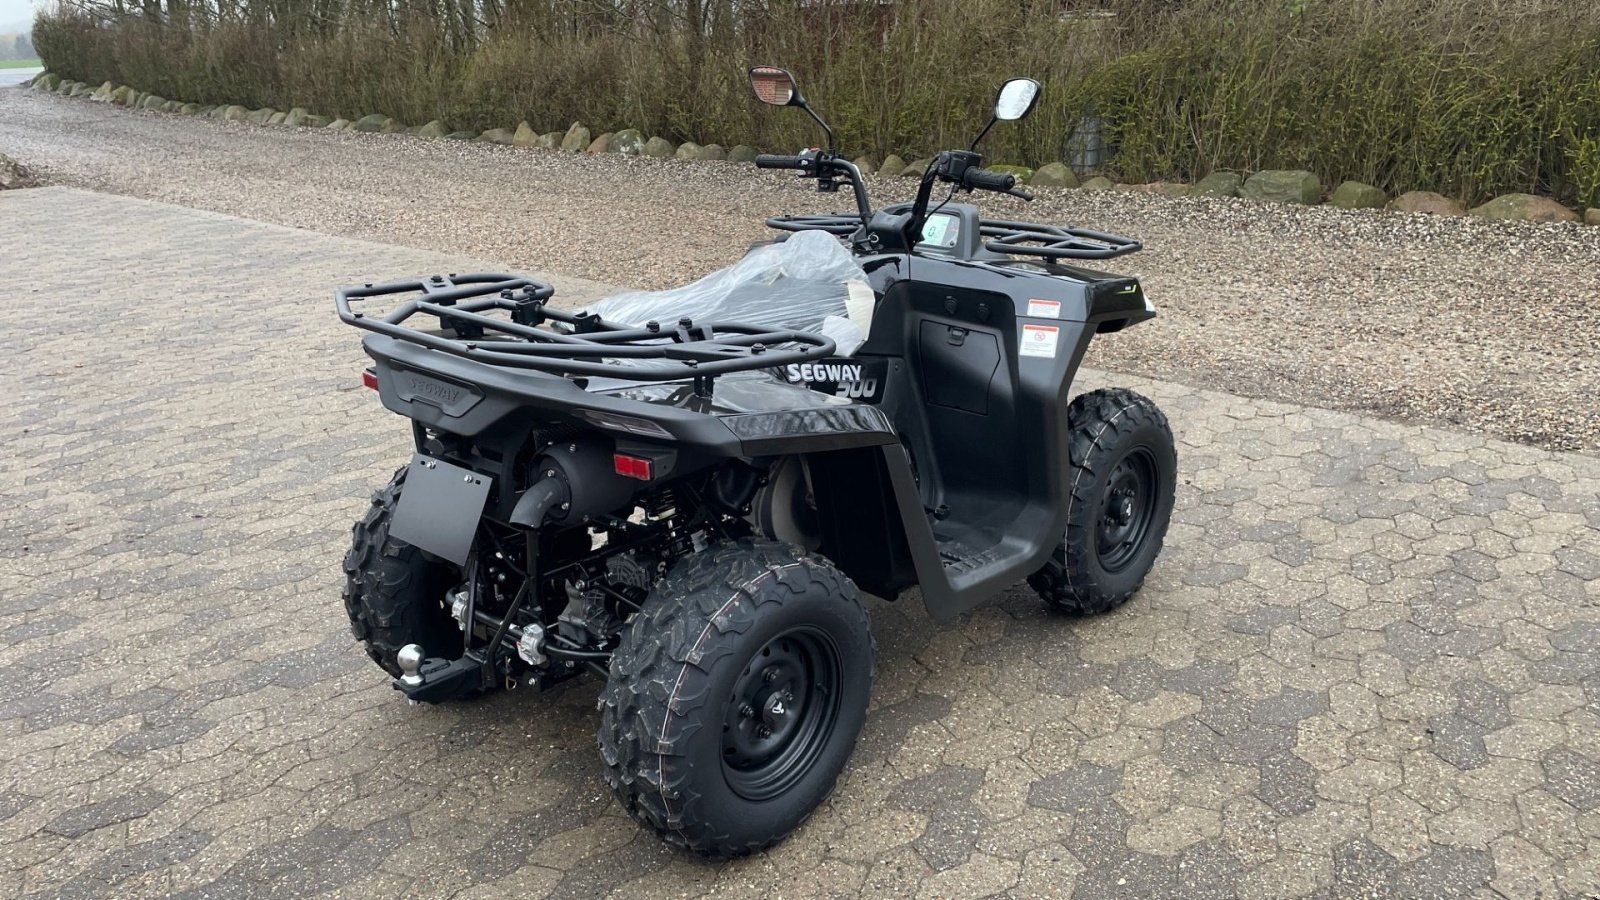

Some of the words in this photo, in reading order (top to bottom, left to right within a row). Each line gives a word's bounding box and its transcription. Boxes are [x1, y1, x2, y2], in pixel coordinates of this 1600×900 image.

[787, 363, 861, 382] SEGWAY
[409, 378, 459, 401] SEGWAY
[835, 380, 877, 398] 500
